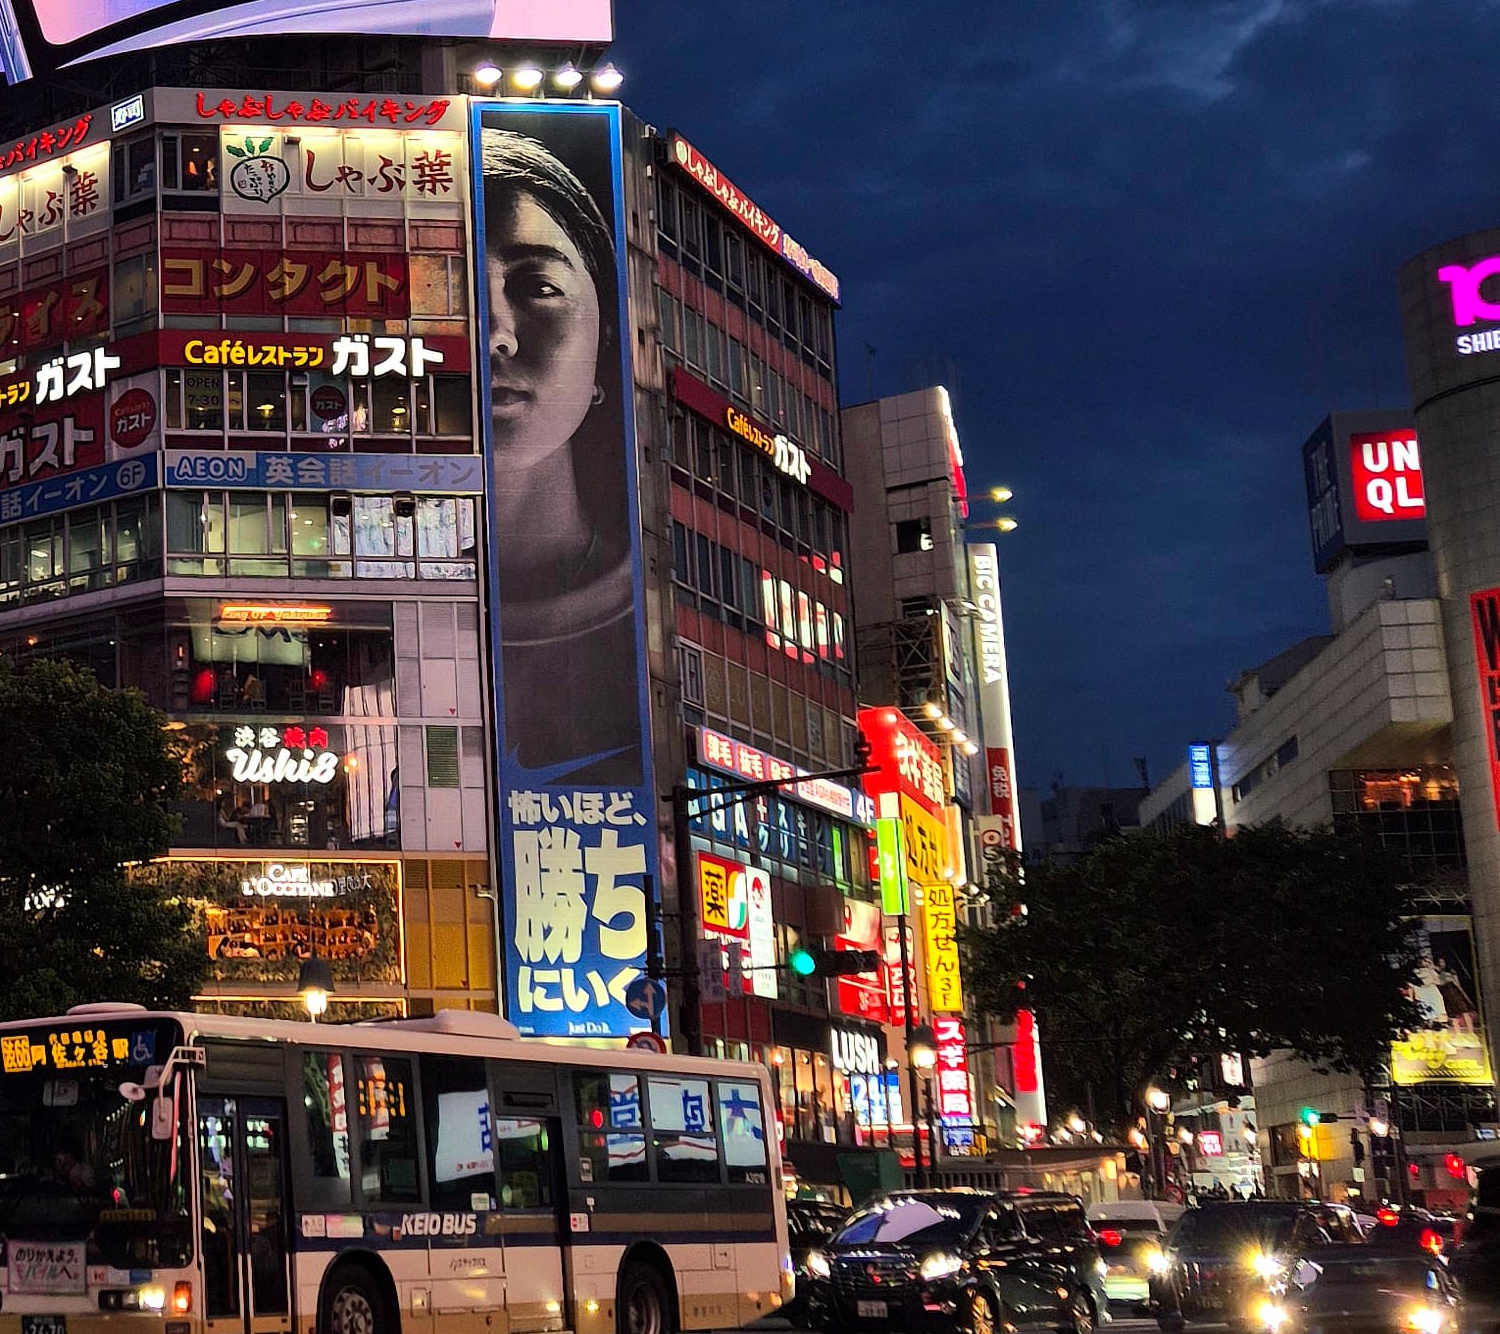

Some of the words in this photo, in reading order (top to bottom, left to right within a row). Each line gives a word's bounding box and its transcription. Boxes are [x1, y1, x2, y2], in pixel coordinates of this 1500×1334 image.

[196, 91, 451, 124] しゃぶしゃぶバイキング
[305, 148, 453, 196] しゃぶ葉
[163, 256, 400, 304] コンタクト
[35, 346, 121, 406] ガスト
[331, 334, 444, 378] ガスト
[116, 415, 152, 435] ガスト
[314, 400, 343, 411] ガスト
[119, 463, 142, 485] 6F
[175, 455, 248, 482] AEON
[264, 455, 476, 485] 英会話イーオン
[773, 434, 812, 485] ガスト
[973, 553, 994, 592] BIC
[976, 597, 1001, 685] CAMERA
[225, 747, 339, 784] Ushi8
[508, 789, 647, 826] 怖いほど、
[856, 794, 875, 824] 4F
[512, 825, 648, 965] 勝ち
[704, 870, 725, 919] 薬
[926, 889, 955, 973] 処方せん
[518, 965, 641, 1014] にいく
[940, 977, 952, 1008] 3F
[830, 1027, 880, 1075] LUSH
[936, 1020, 970, 1115] スギ薬局
[401, 1212, 440, 1235] KEIO
[442, 1213, 477, 1235] BUS
